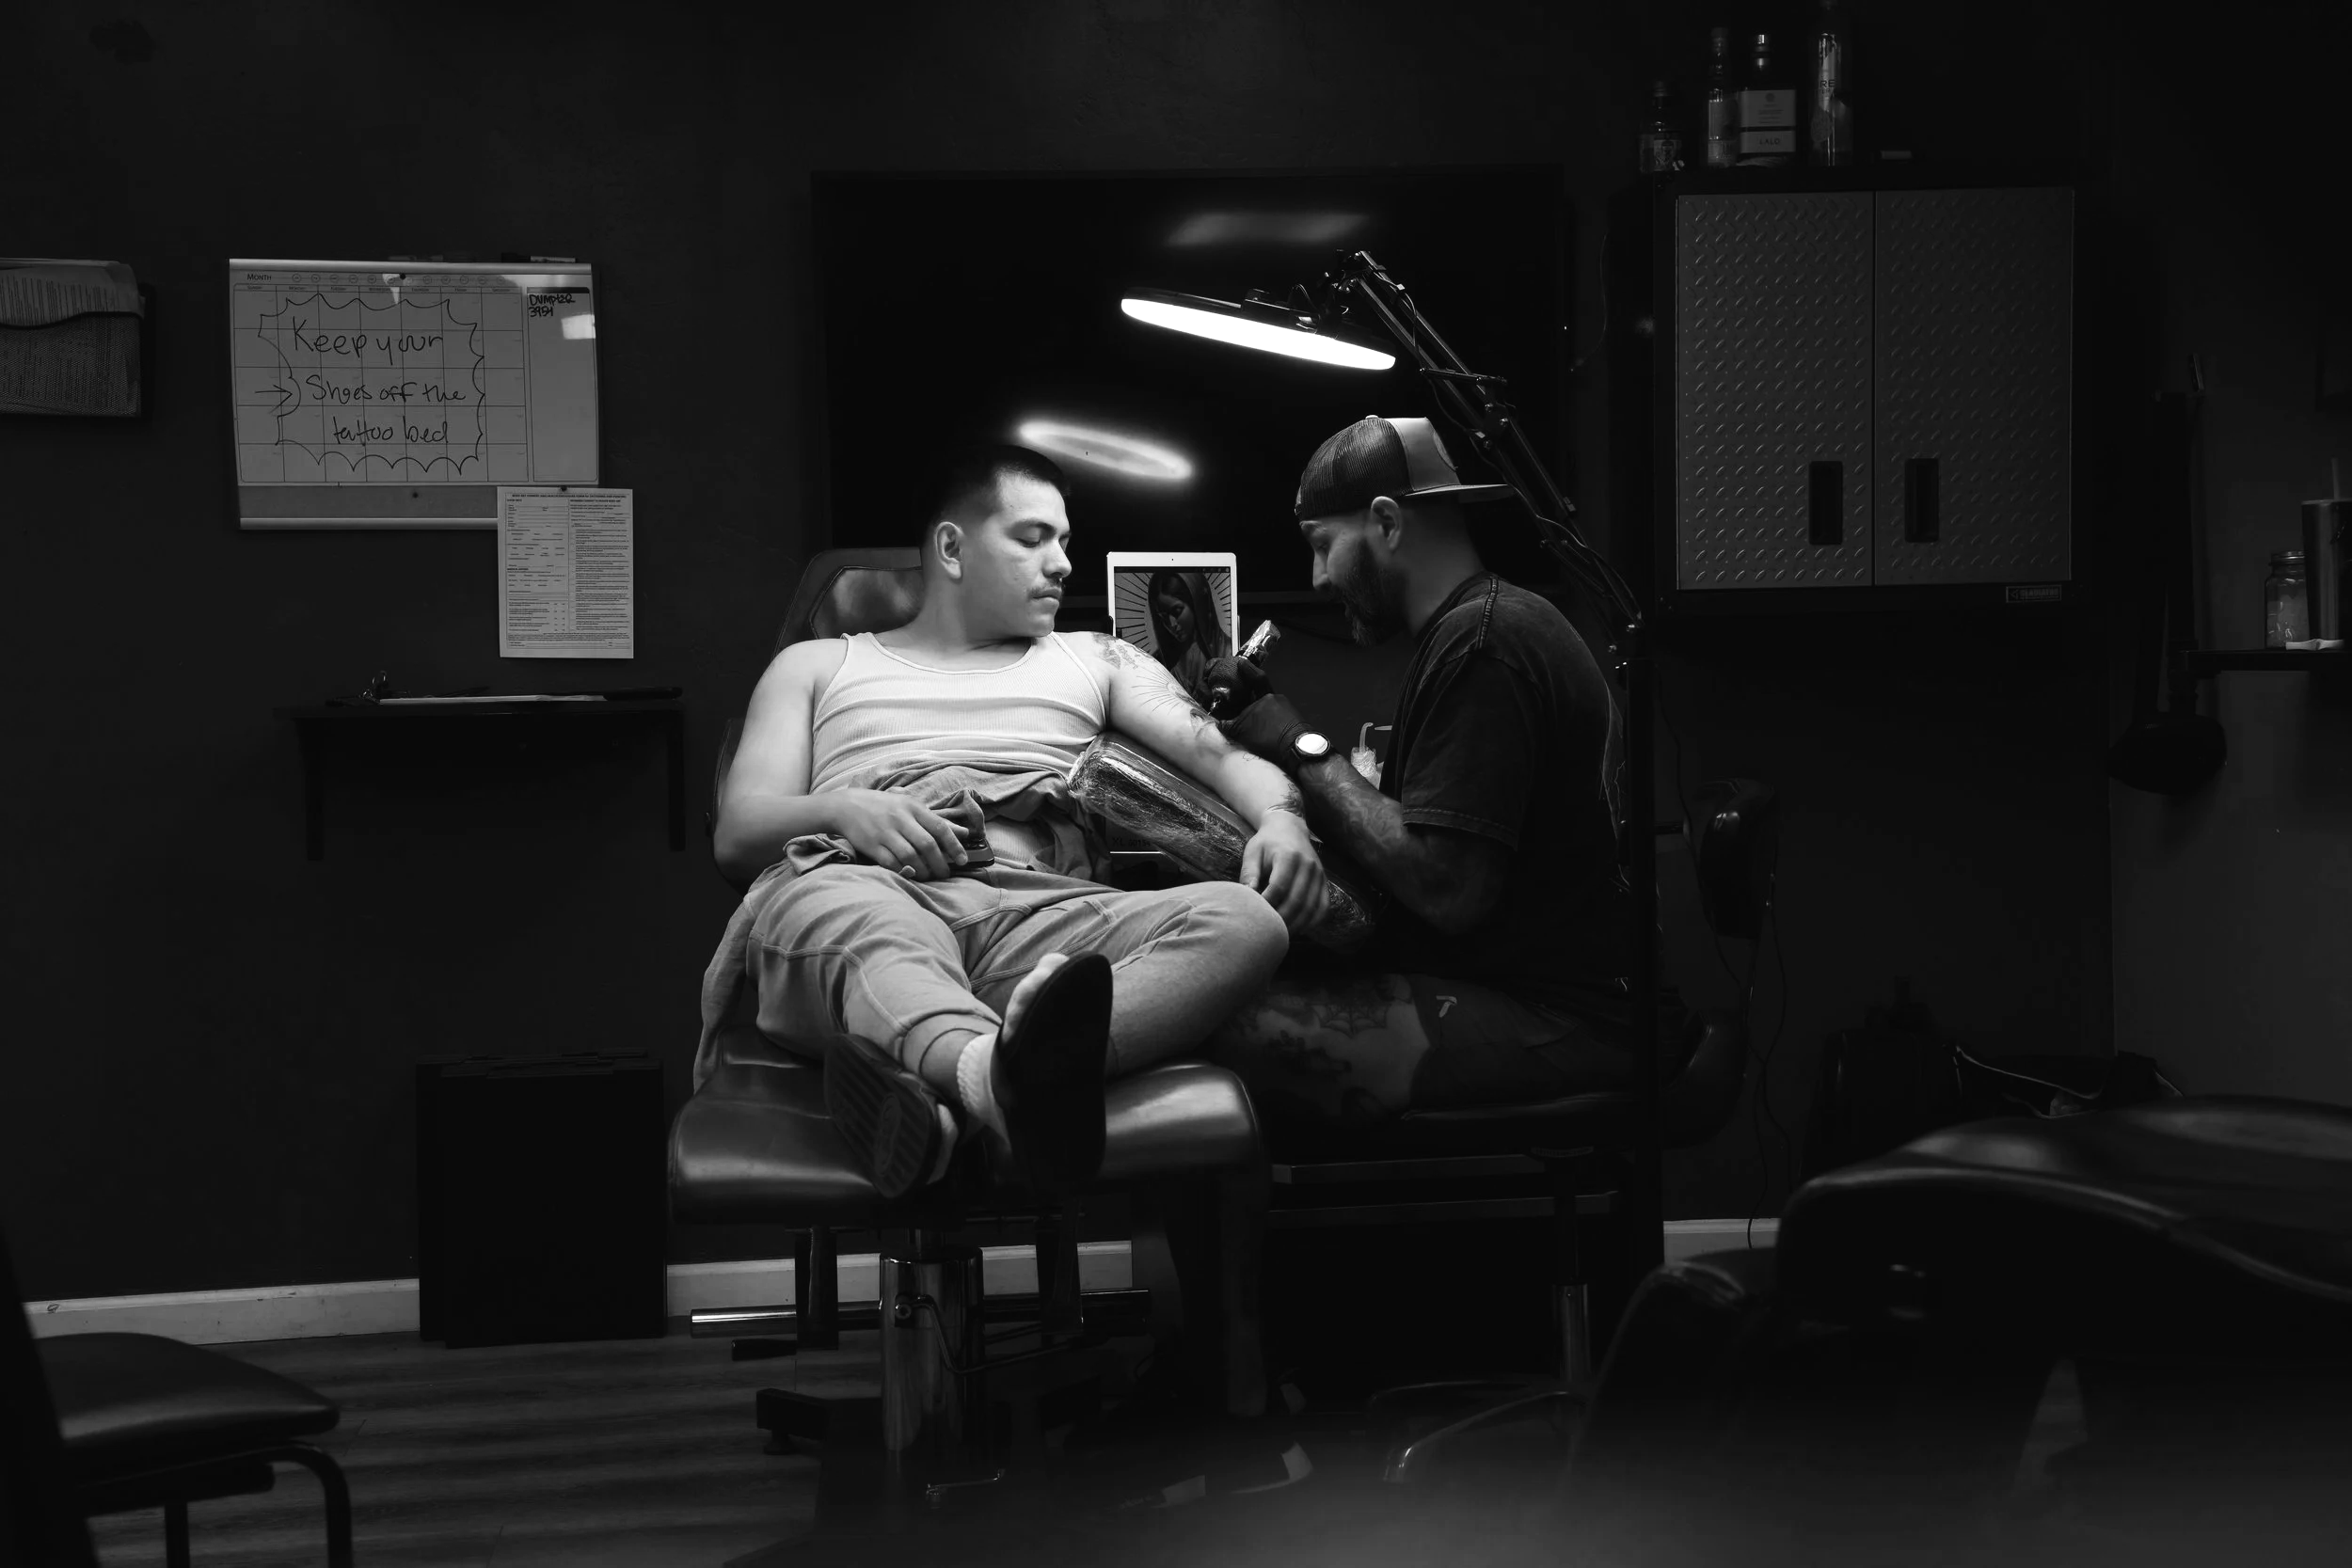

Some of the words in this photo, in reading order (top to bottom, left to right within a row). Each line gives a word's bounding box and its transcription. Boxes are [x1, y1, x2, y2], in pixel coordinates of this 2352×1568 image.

[293, 316, 368, 358] Keep
[375, 335, 443, 366] your
[306, 374, 373, 404] Shoes
[379, 381, 418, 403] off
[422, 383, 467, 403] the
[333, 416, 394, 446] tattoo
[403, 415, 449, 443] bed
